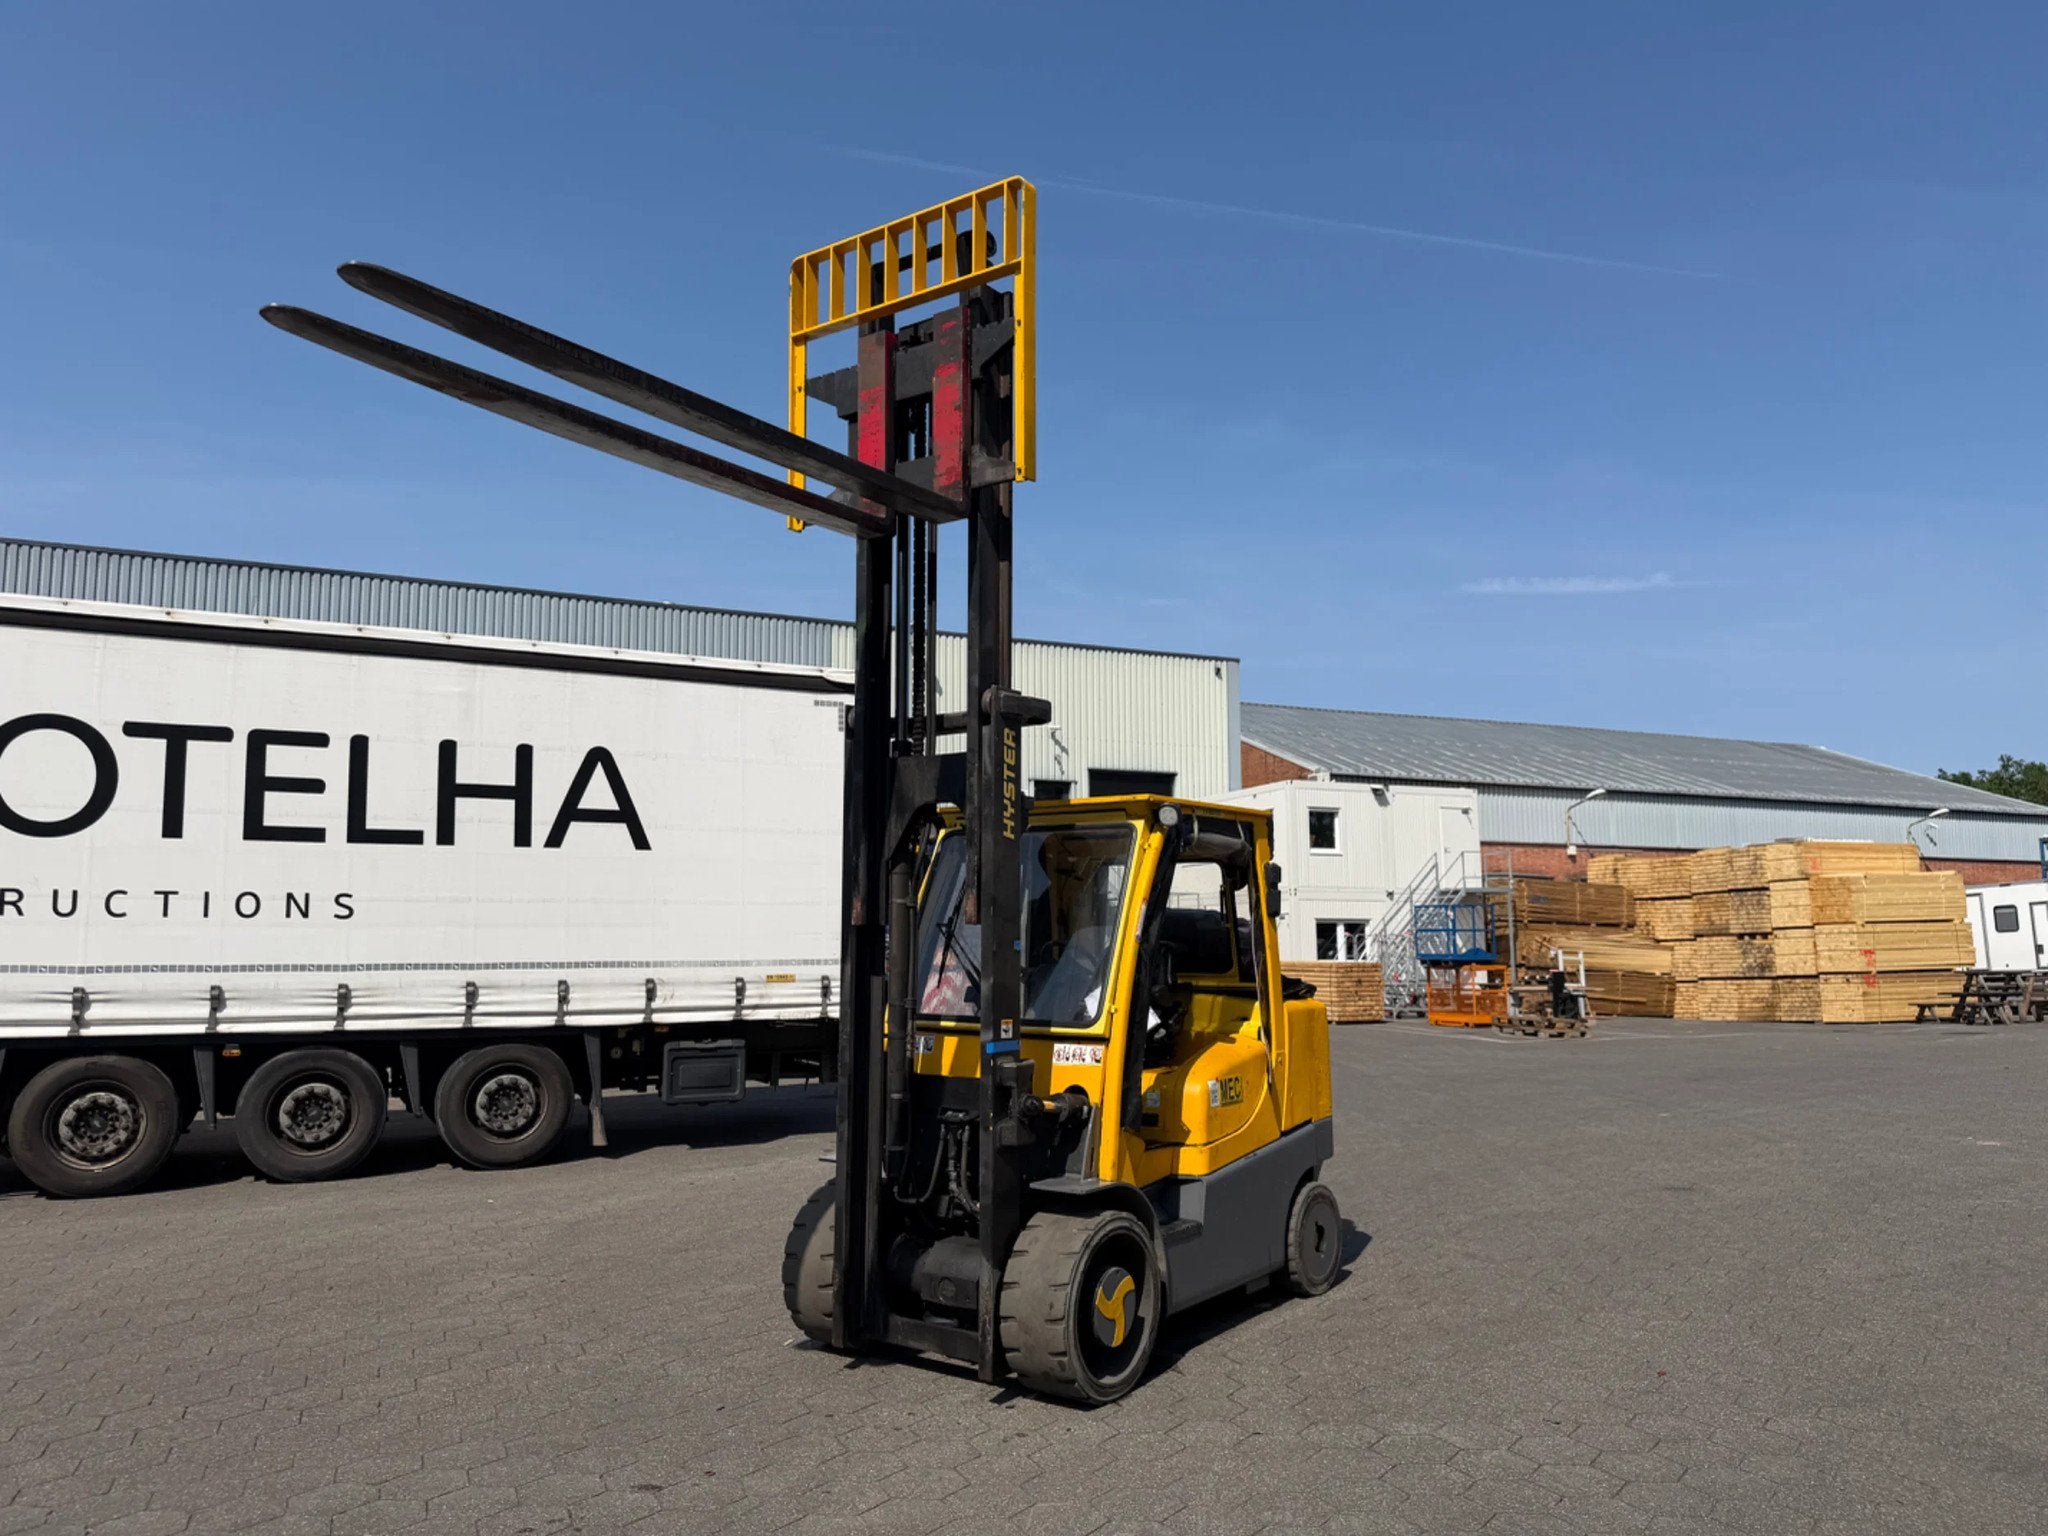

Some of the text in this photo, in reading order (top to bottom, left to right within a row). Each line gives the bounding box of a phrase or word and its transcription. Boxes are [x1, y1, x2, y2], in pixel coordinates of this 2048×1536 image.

[0, 713, 652, 850] OTELHA
[1003, 726, 1017, 840] HYSTER
[0, 887, 355, 919] RUCTIONS
